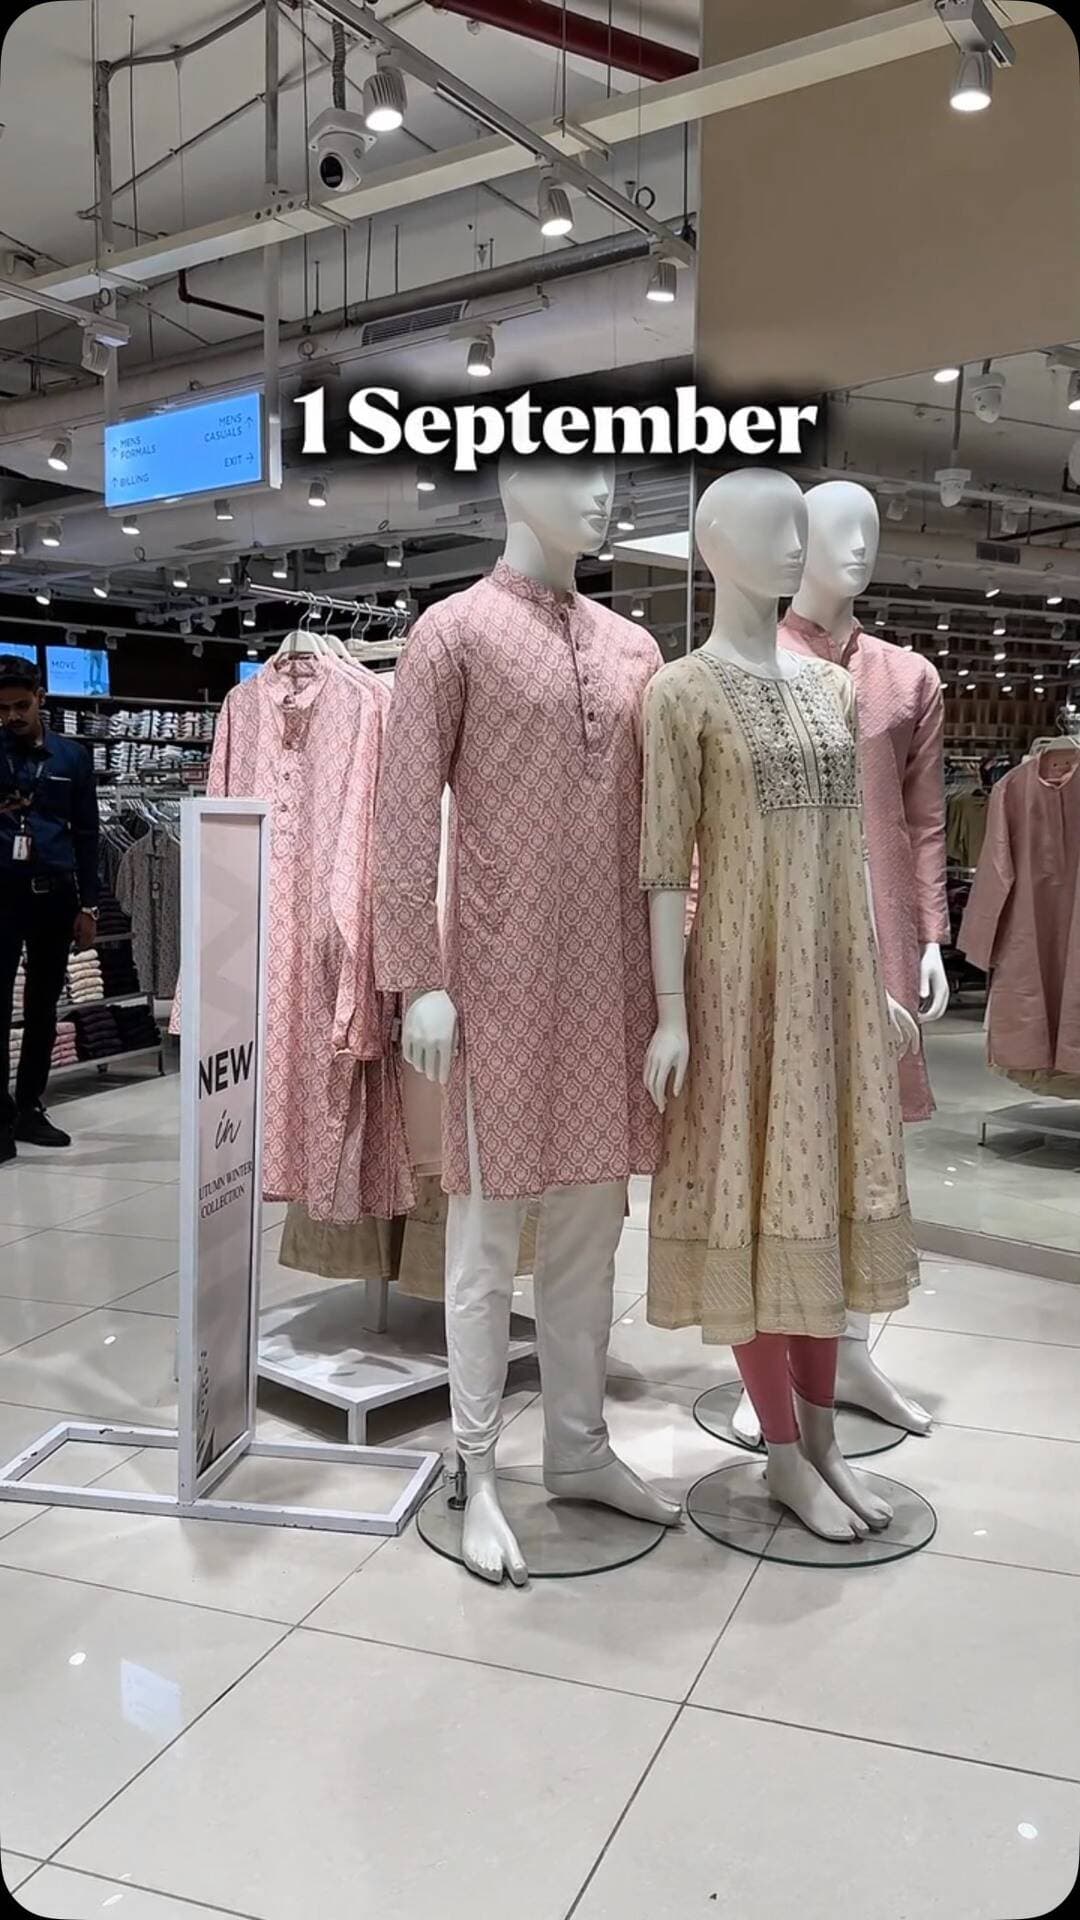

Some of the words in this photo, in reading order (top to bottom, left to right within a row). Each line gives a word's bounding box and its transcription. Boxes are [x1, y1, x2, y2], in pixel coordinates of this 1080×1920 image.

[218, 413, 242, 427] MENS
[120, 436, 141, 448] MENS
[205, 427, 242, 442] CASUALS
[120, 444, 157, 460] FORMALS
[224, 455, 242, 467] EXIT
[198, 1040, 254, 1099] NEW
[215, 1109, 241, 1149] in
[198, 1176, 225, 1200] UTUMN
[200, 1185, 245, 1218] COLLECTION
